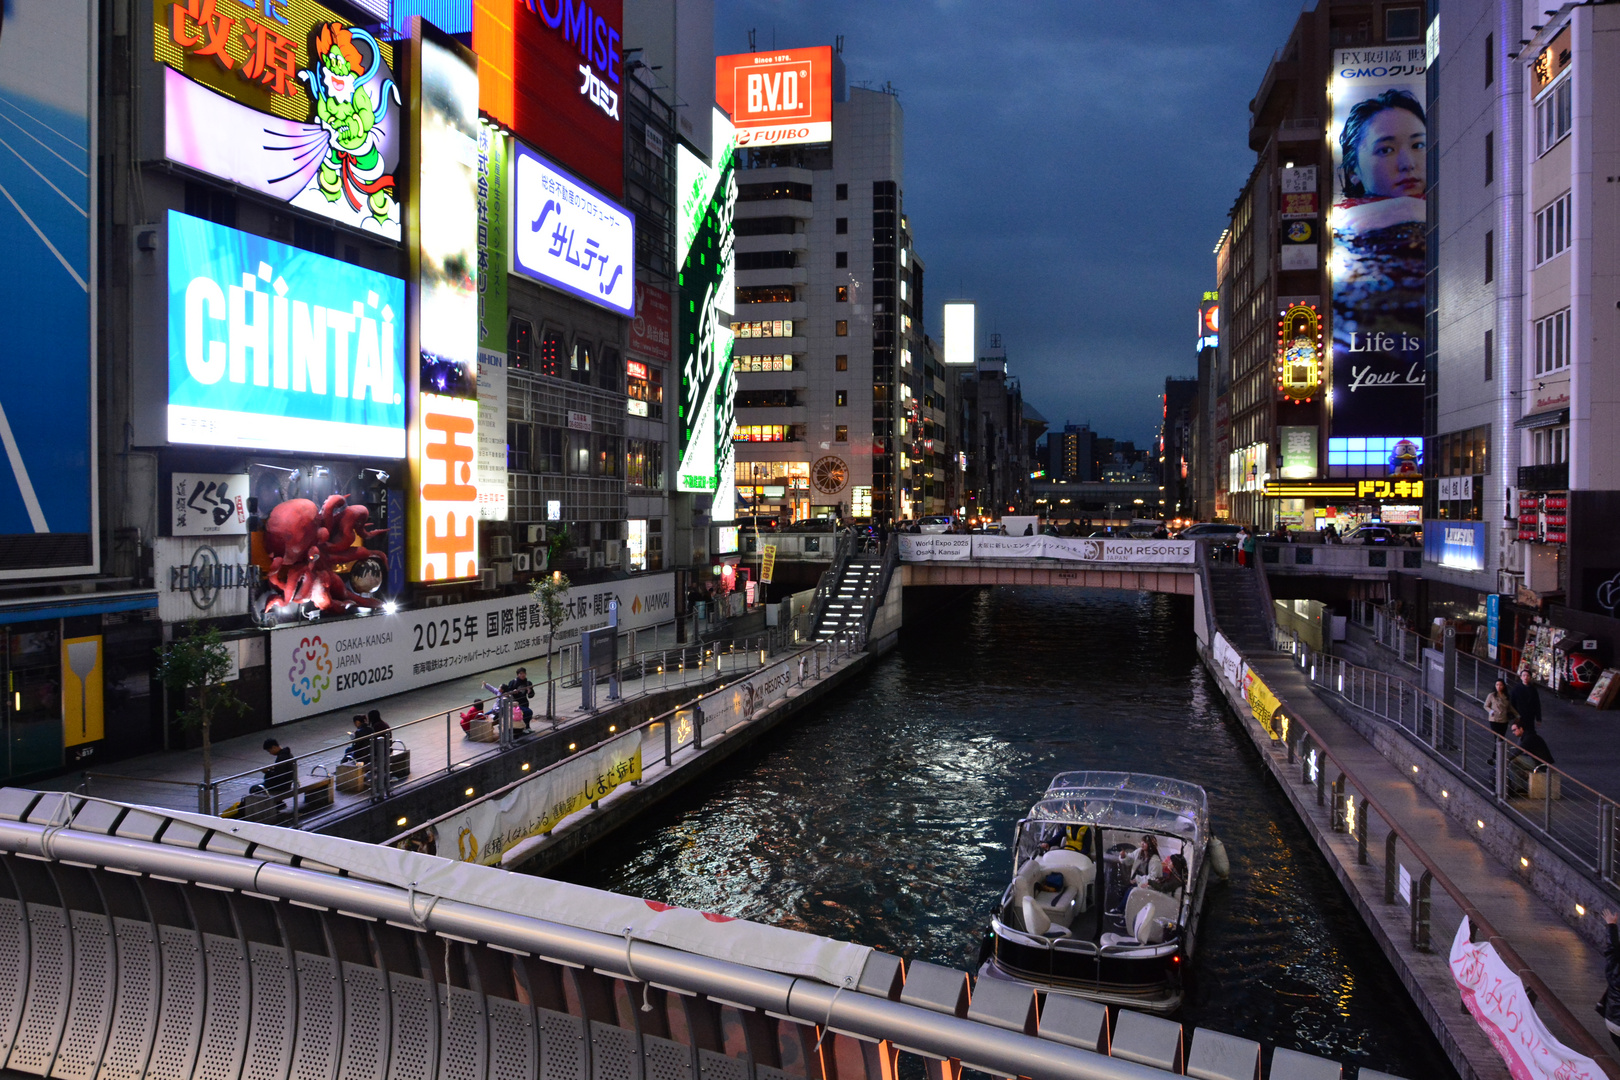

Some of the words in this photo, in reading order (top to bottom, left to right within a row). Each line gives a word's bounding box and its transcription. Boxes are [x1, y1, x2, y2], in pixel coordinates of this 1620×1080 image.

[172, 0, 298, 97] 改源
[579, 64, 619, 121] プロミス
[748, 71, 803, 113] B.V.D.
[754, 128, 809, 143] FUJIBO
[548, 222, 609, 277] サムティ
[1348, 331, 1395, 352] Life
[1402, 331, 1420, 351] is
[1350, 365, 1400, 392] Your
[1288, 432, 1311, 453] 薬
[187, 481, 235, 526] くくる
[380, 489, 387, 518] 2F
[915, 539, 934, 547] World
[935, 539, 952, 548] Expo
[1106, 546, 1133, 555] MGM
[1136, 546, 1190, 556] RESORTS
[762, 545, 776, 580] Coffee
[644, 592, 670, 613] NANKAI
[336, 632, 393, 653] OSAKA-KANSAI
[413, 615, 478, 652] 2025年
[514, 638, 531, 652] 2025年
[336, 654, 361, 669] JAPAN
